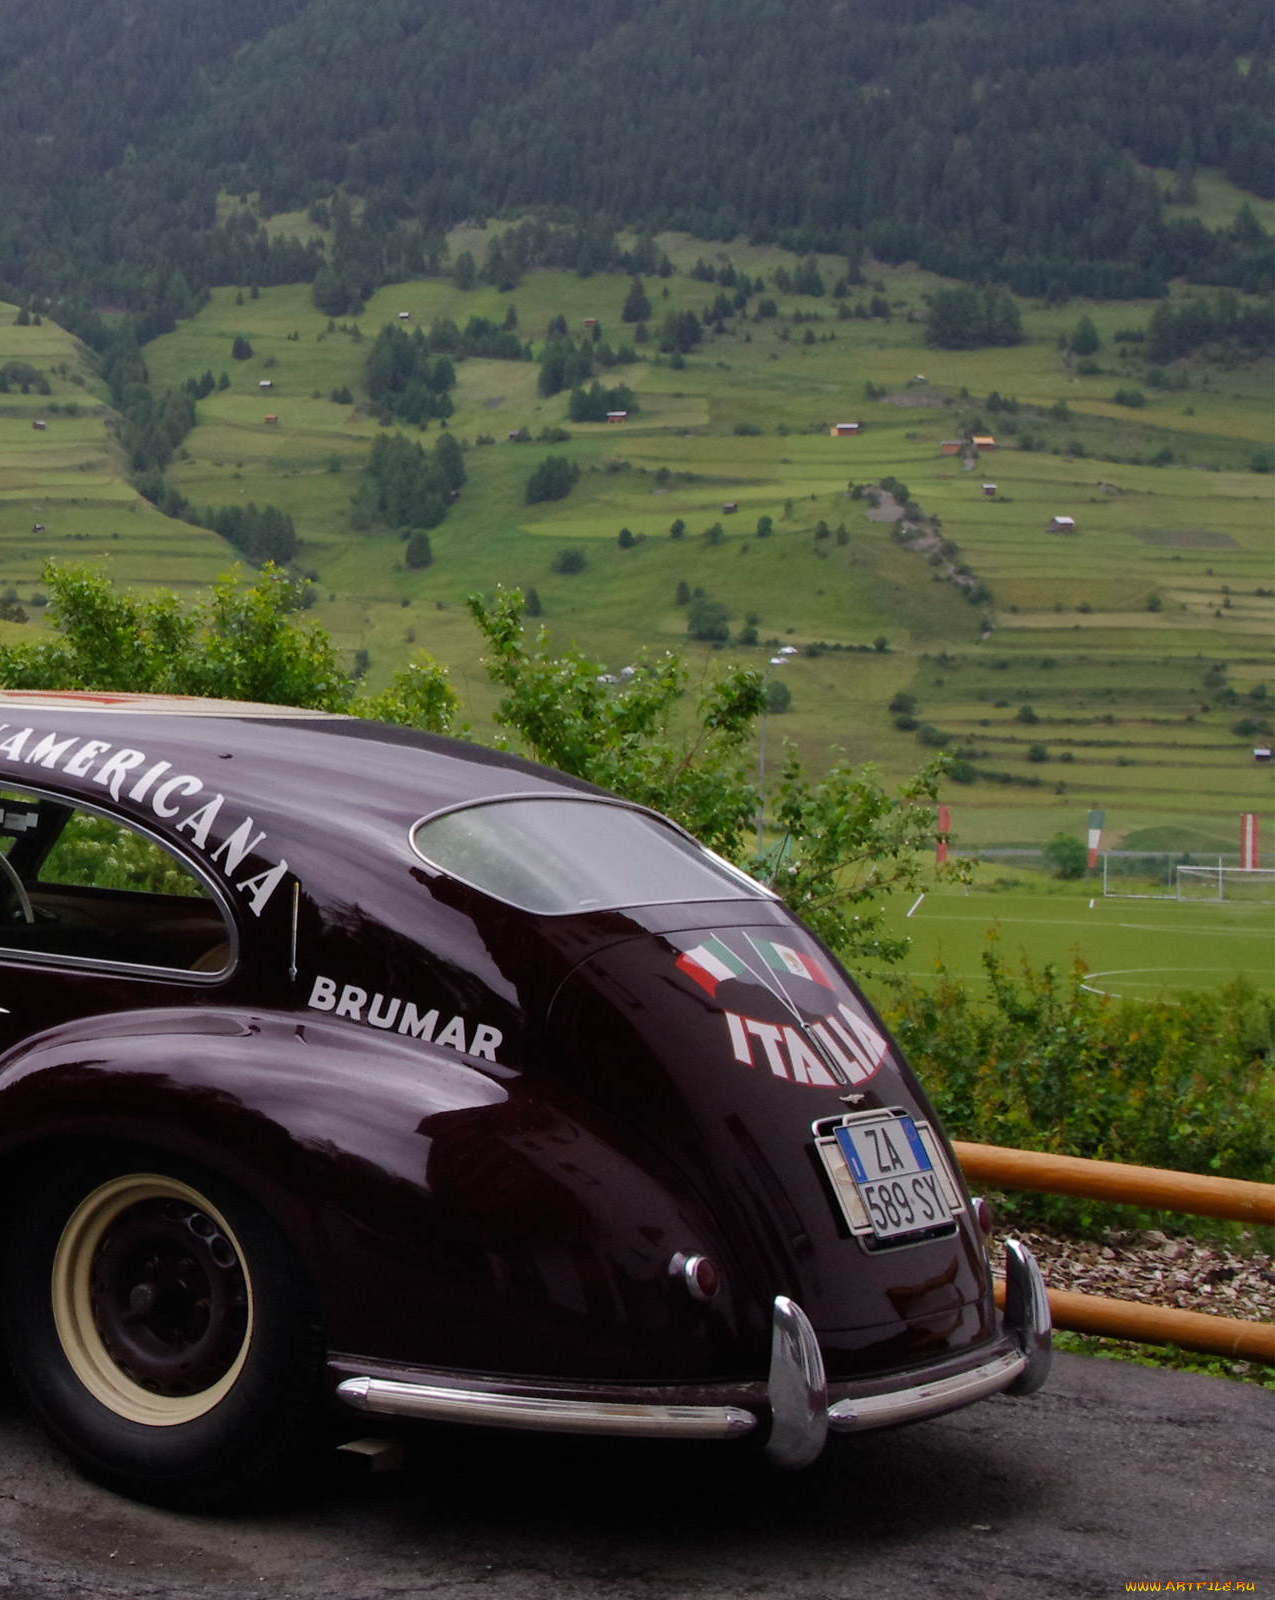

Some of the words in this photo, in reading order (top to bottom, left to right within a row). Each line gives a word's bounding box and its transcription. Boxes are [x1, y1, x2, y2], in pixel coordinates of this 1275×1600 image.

[308, 975, 504, 1063] BRUMAR
[724, 1001, 889, 1089] ITALIA
[863, 1127, 905, 1173] ZA
[864, 1181, 915, 1231] 589
[911, 1174, 946, 1221] SY
